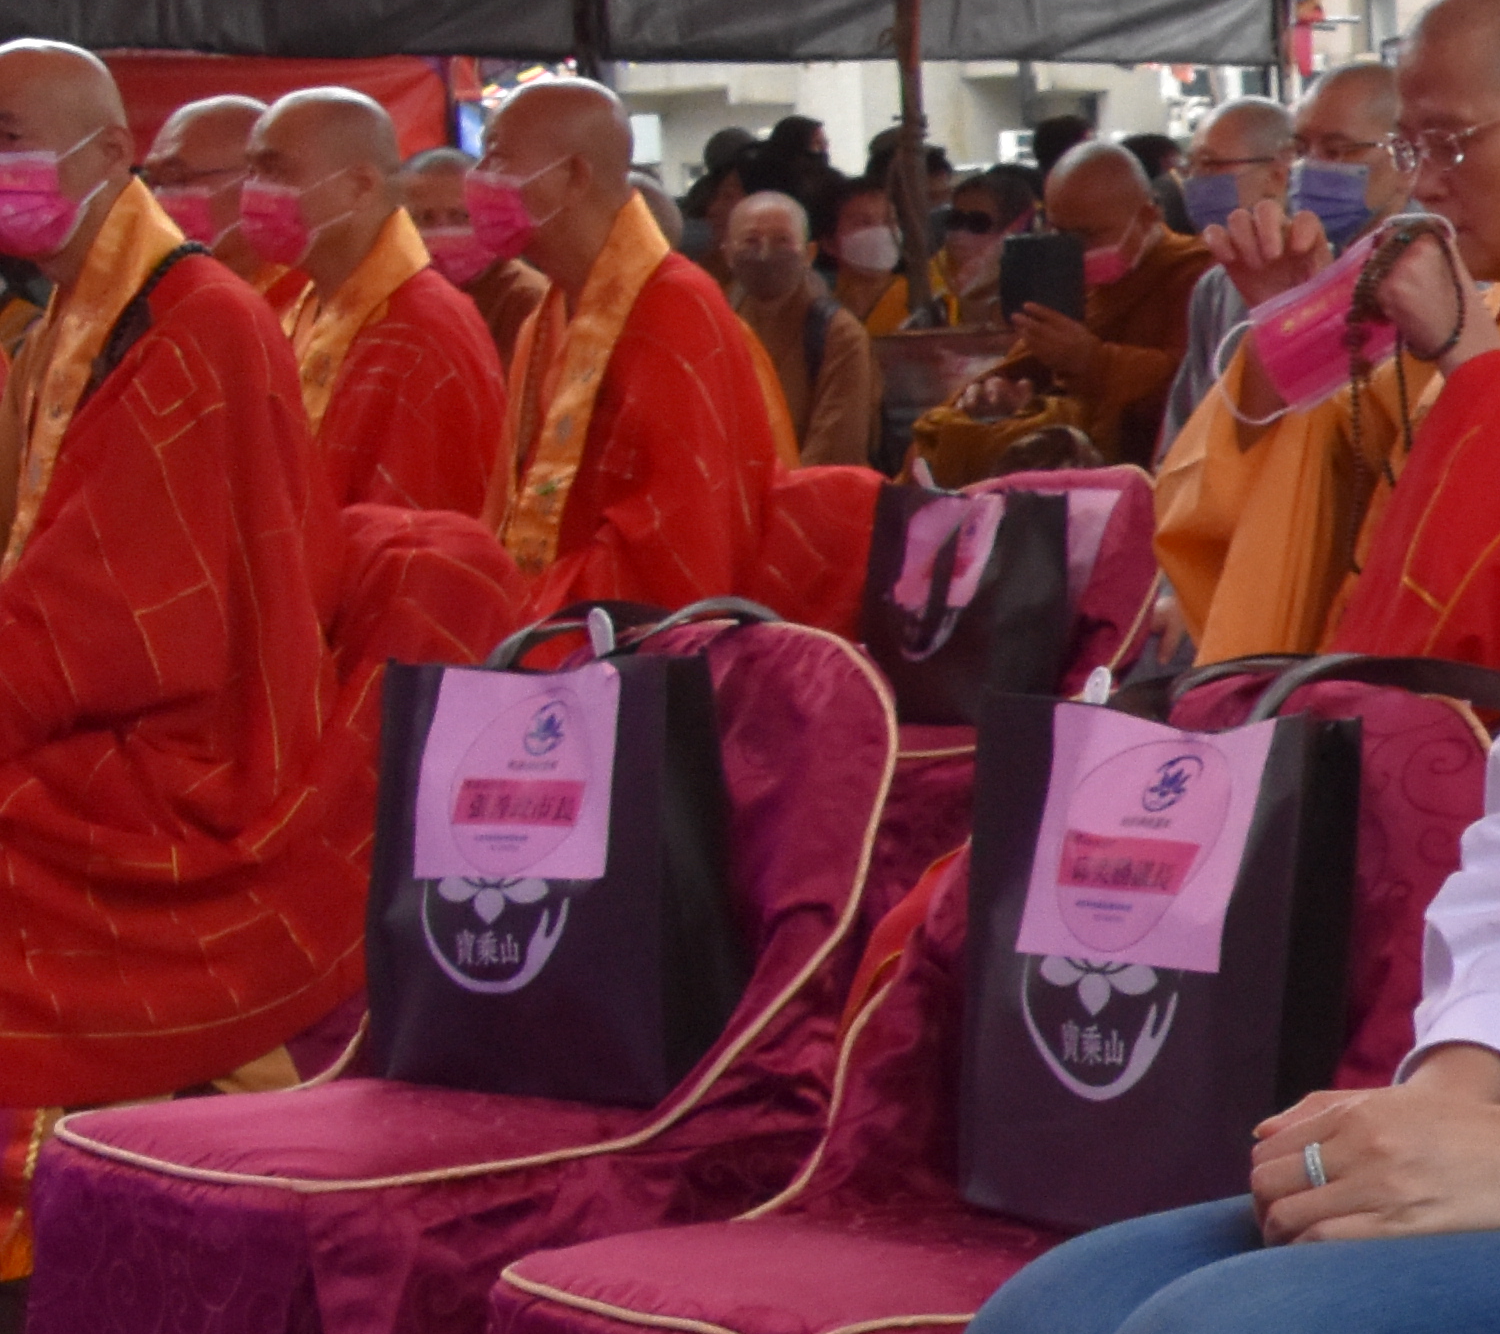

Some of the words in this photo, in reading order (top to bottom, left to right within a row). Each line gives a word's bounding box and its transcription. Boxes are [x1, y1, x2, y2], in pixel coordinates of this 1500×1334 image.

[455, 927, 522, 967] 寶乘山
[1060, 1019, 1125, 1067] 寶乘山
